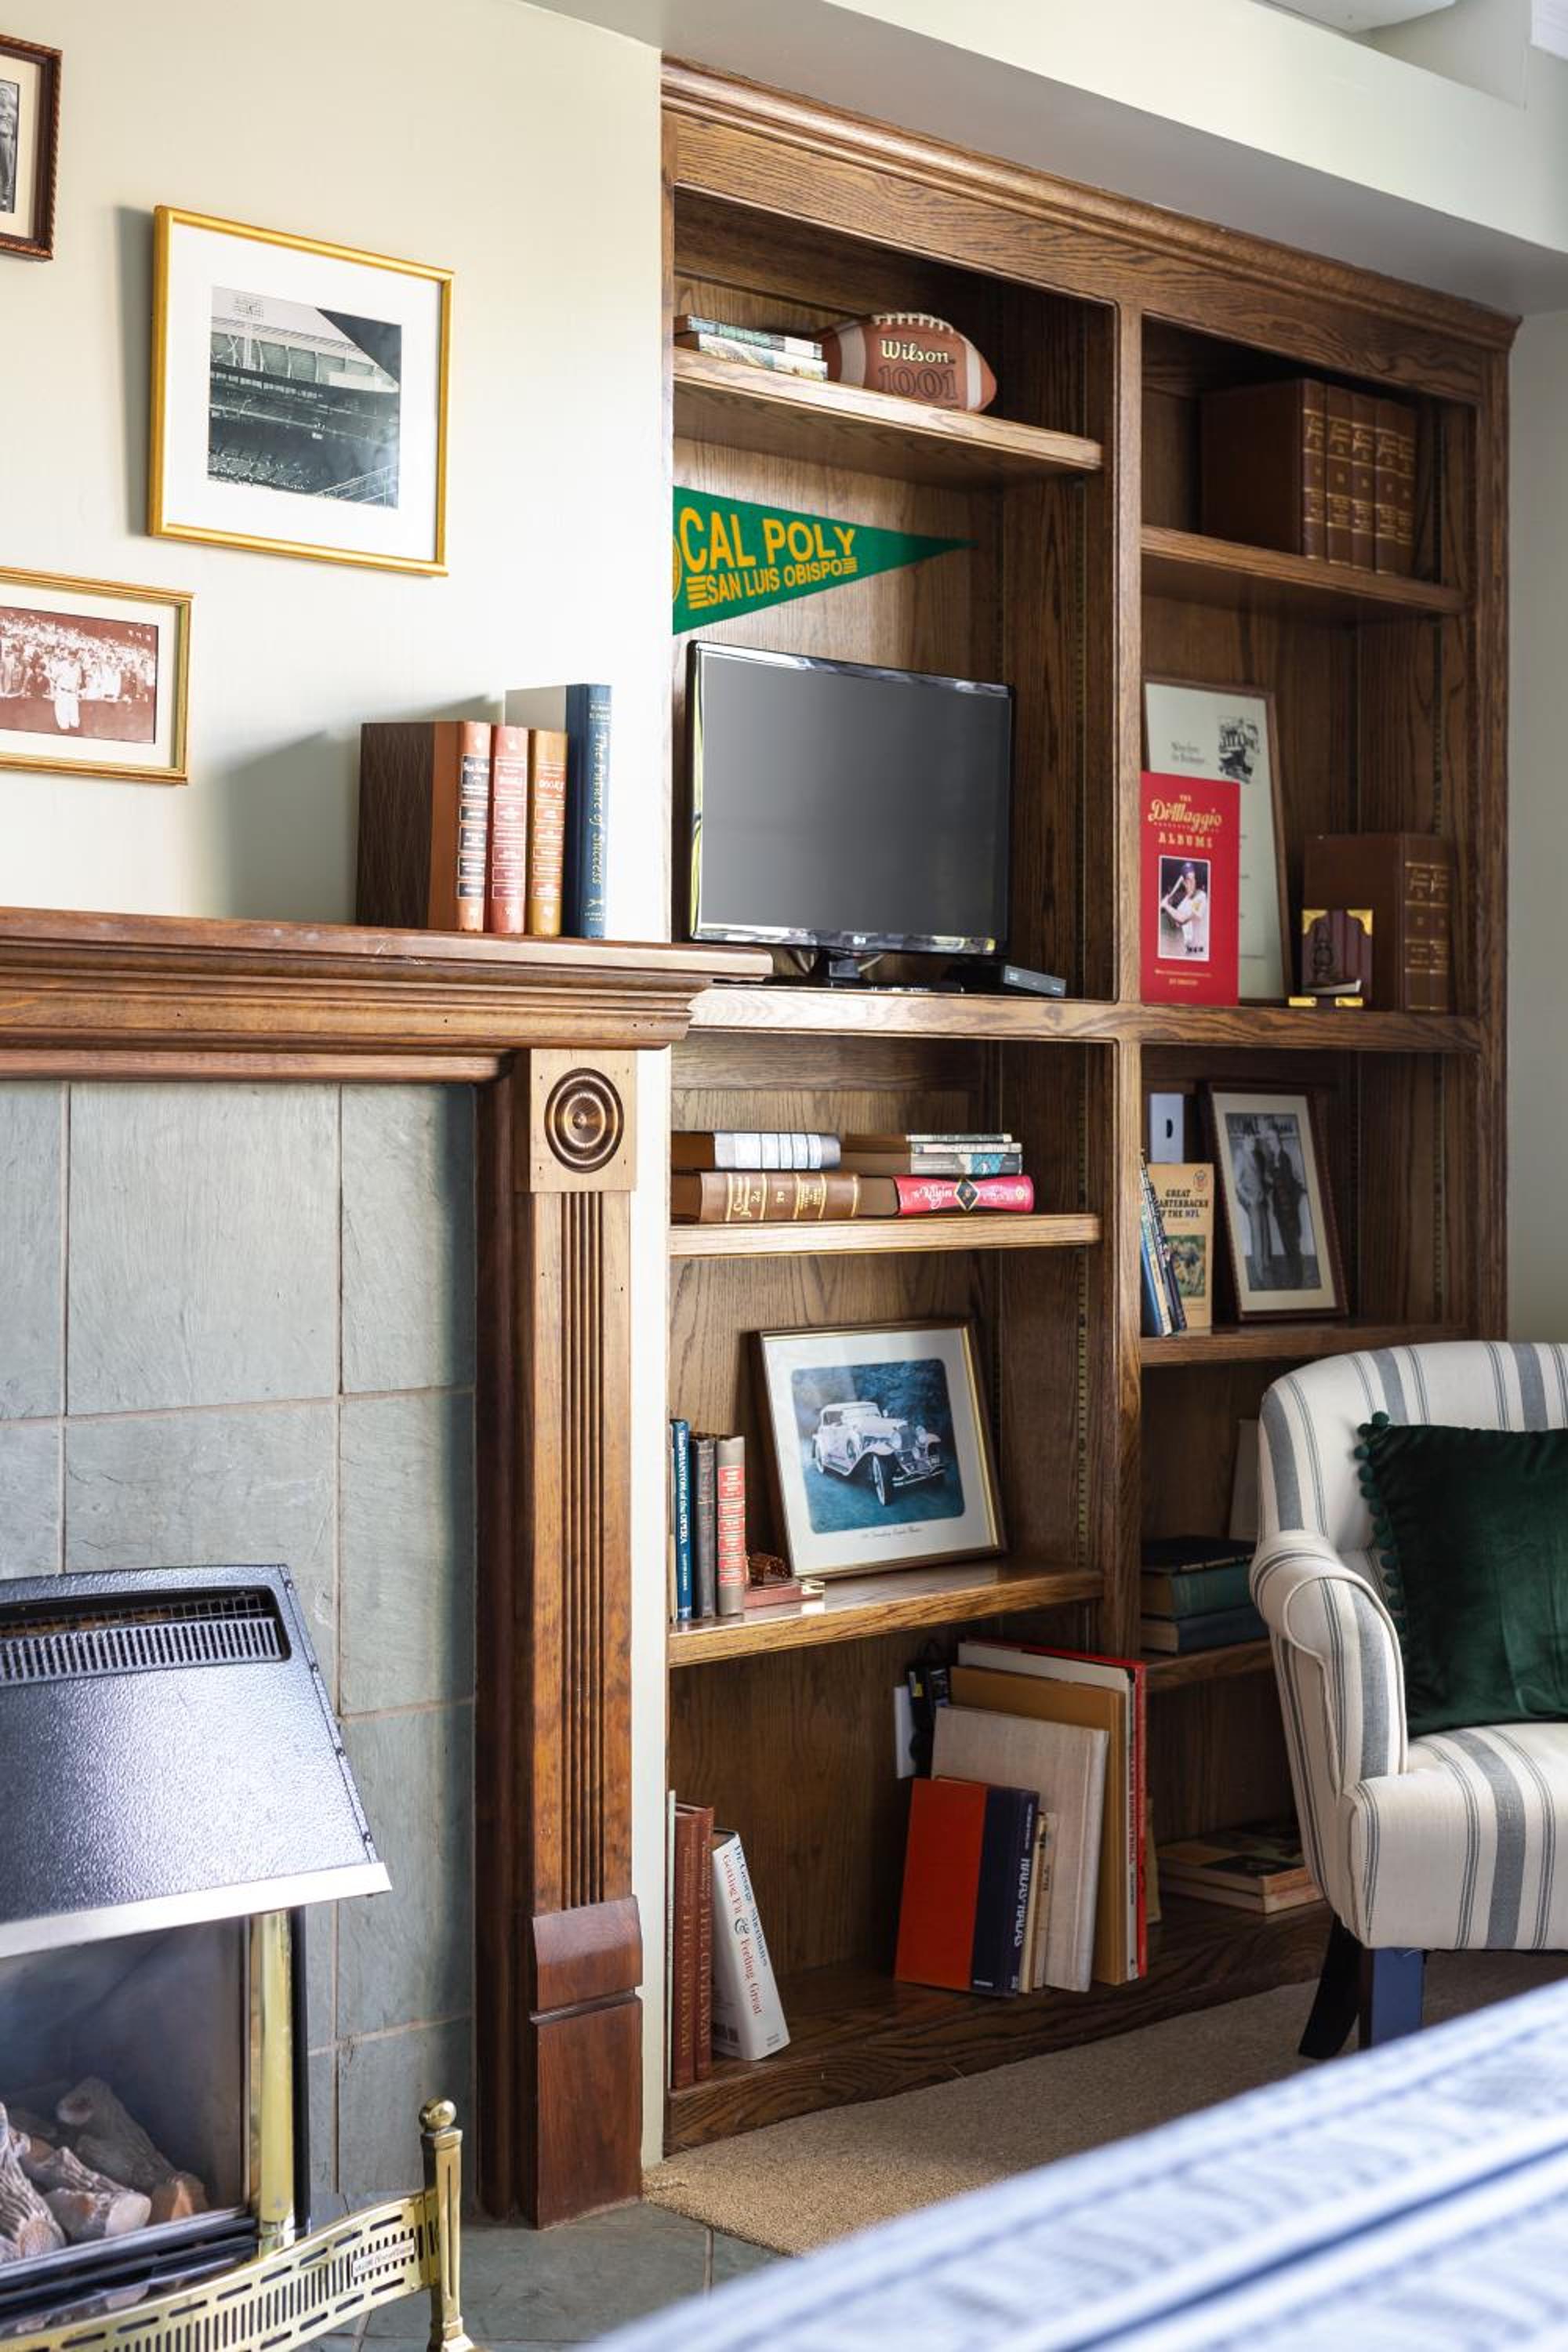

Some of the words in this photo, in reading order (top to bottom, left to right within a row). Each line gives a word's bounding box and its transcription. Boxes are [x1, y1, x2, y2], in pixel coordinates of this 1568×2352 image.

[880, 339, 949, 363] Wilson
[878, 365, 957, 401] 1001
[680, 507, 756, 573] CAL
[763, 518, 855, 561] POLY
[706, 574, 742, 604] SAN
[744, 567, 780, 597] LUIS
[783, 558, 843, 588] OBISPO
[1148, 799, 1222, 834] DiMaggio
[1166, 1189, 1191, 1198] GREAT
[1018, 1858, 1030, 1900] HALAS
[1014, 1904, 1025, 1947] HALAS
[735, 1918, 749, 1935] &
[750, 1982, 765, 2015] Great
